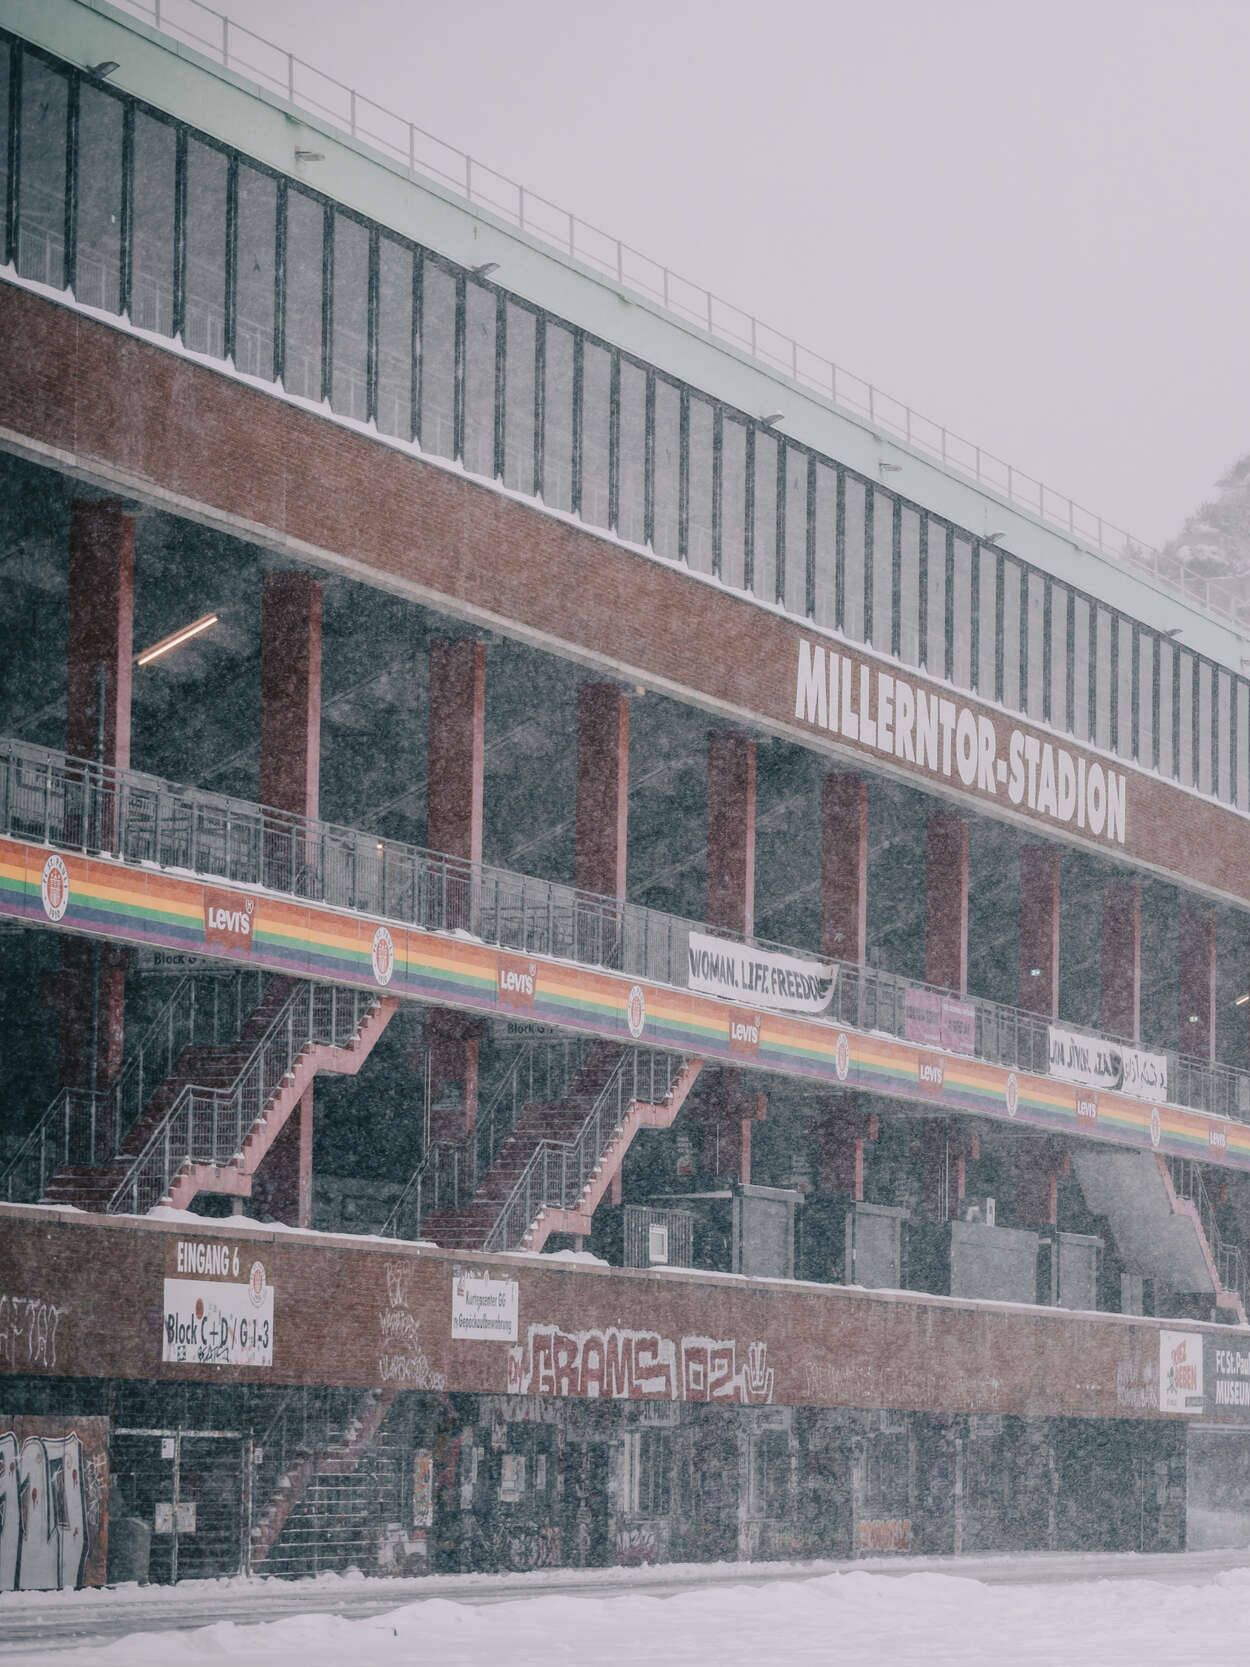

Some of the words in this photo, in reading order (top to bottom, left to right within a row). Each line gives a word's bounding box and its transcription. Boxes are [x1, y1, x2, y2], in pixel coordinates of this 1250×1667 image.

[795, 638, 1126, 844] MILLERNTOR-STADION
[689, 948, 739, 988] WOMAN.
[177, 1241, 230, 1275] EINGANG
[232, 1246, 240, 1277] 6
[167, 1311, 198, 1345] Block
[200, 1315, 208, 1346] C
[209, 1320, 219, 1346] +
[220, 1316, 229, 1347] D
[240, 1318, 248, 1348] G
[1215, 1349, 1226, 1374] FC
